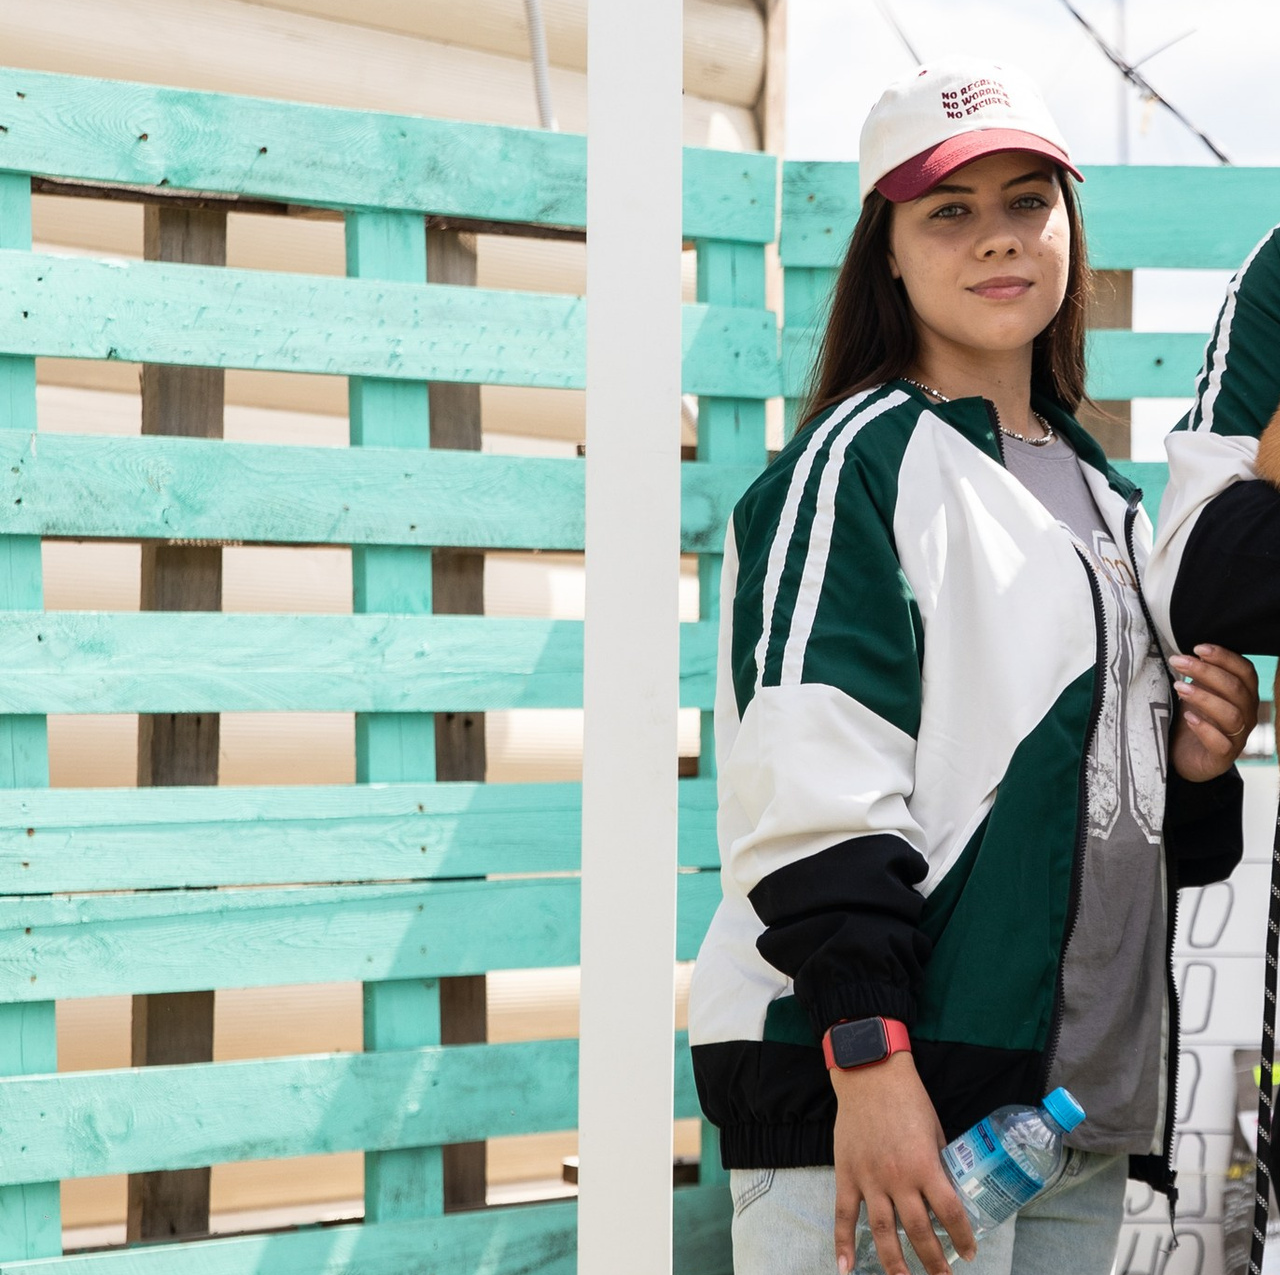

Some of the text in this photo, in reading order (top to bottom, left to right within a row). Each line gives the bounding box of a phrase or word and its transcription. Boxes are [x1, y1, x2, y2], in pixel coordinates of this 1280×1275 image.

[941, 91, 958, 100] NO
[942, 101, 959, 110] NO
[946, 111, 963, 119] NO
